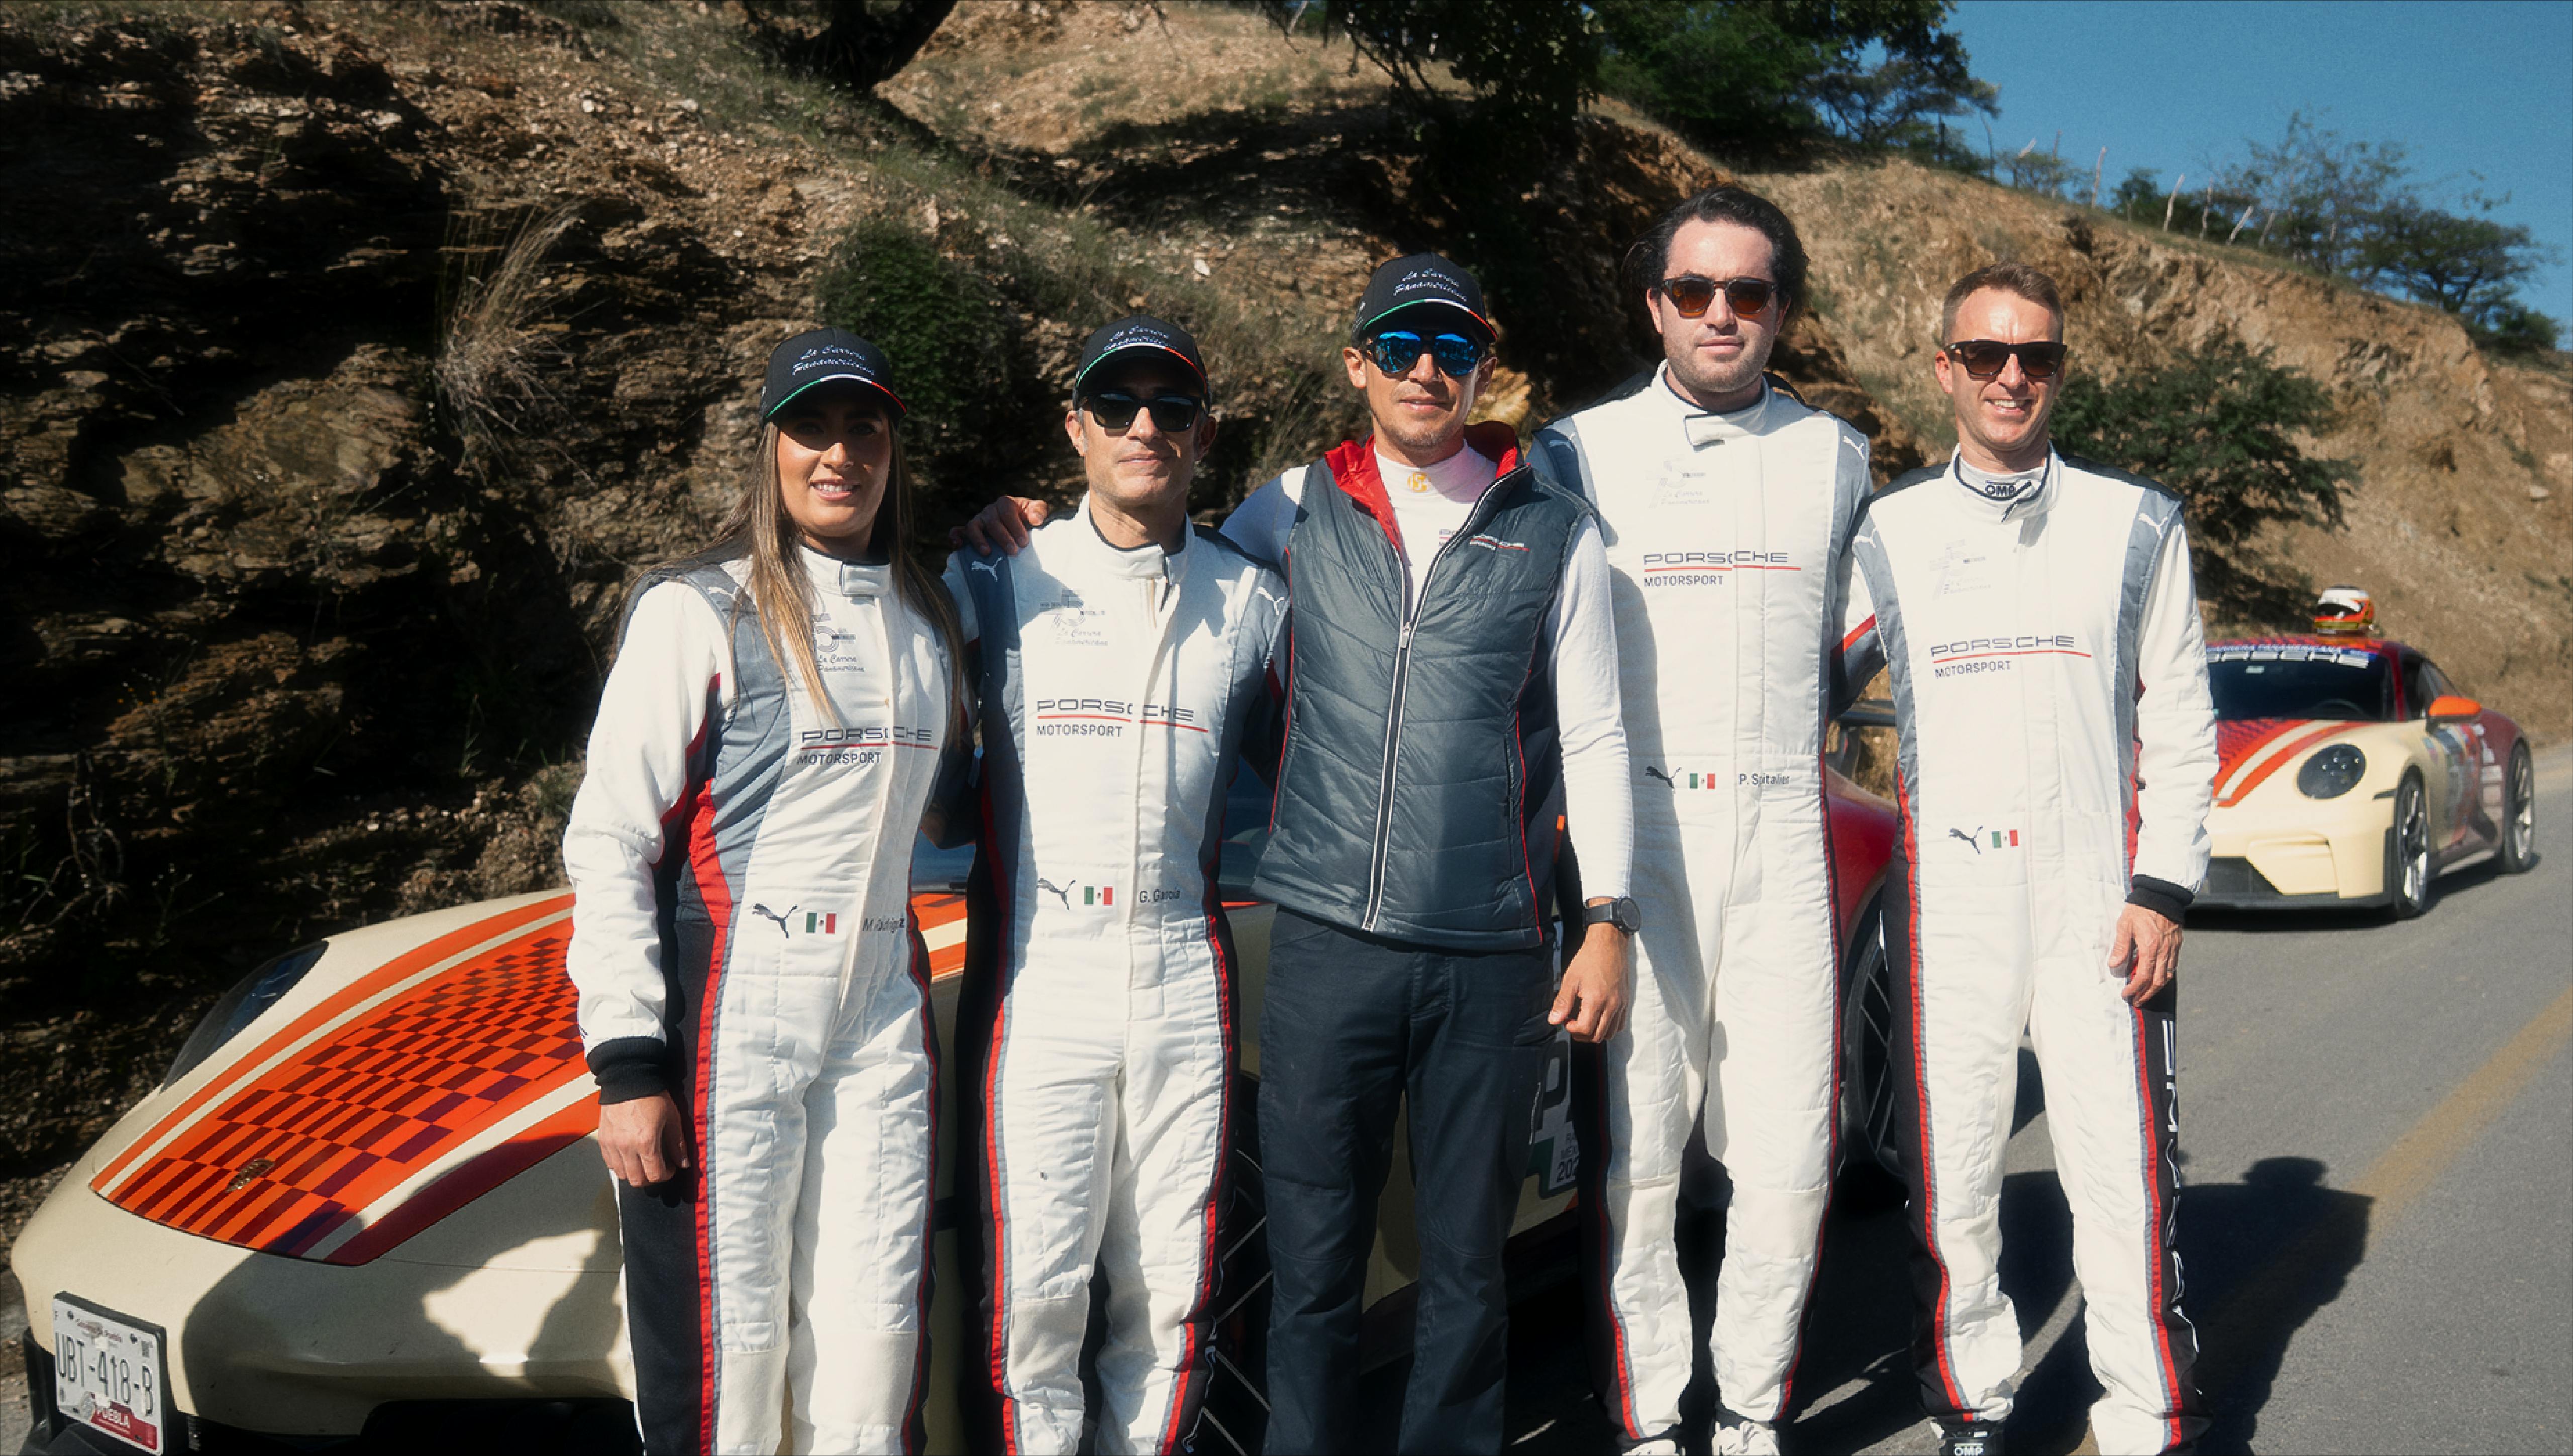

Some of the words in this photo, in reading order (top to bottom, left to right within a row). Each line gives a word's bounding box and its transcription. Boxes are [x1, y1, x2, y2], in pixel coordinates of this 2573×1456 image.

[1985, 484, 2016, 496] OMP
[1643, 551, 1788, 565] PORSCHE
[1644, 575, 1724, 587] MOTORSPORT
[1930, 635, 2075, 657] PORSCHE
[1935, 660, 2011, 678] MOTORSPORT
[1037, 698, 1194, 722] PORSCHE
[801, 726, 932, 743] PORSCHE
[1037, 724, 1122, 737] MOTORSPORT
[796, 752, 881, 765] MOTORSPORT
[1738, 772, 1749, 785] P.
[1139, 890, 1151, 903] G.
